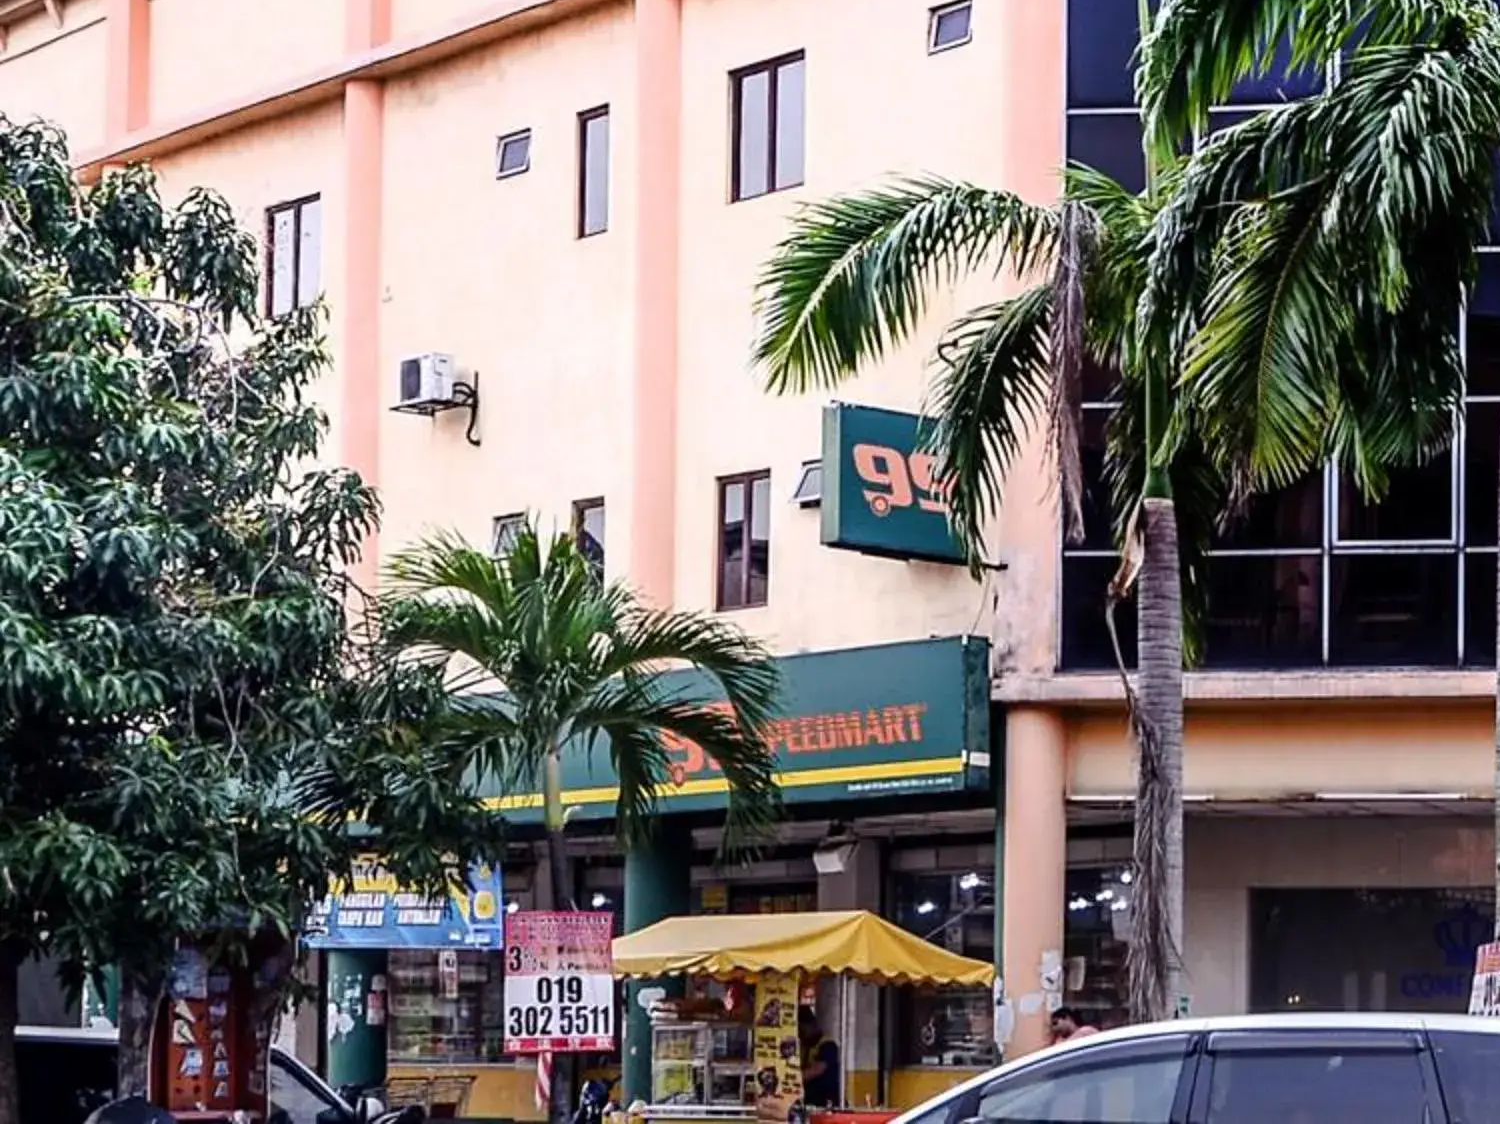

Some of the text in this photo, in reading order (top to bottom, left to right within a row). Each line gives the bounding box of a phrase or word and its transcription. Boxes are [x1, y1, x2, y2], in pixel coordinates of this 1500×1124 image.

[537, 976, 583, 1004] 019
[509, 1005, 610, 1037] 302 5511
